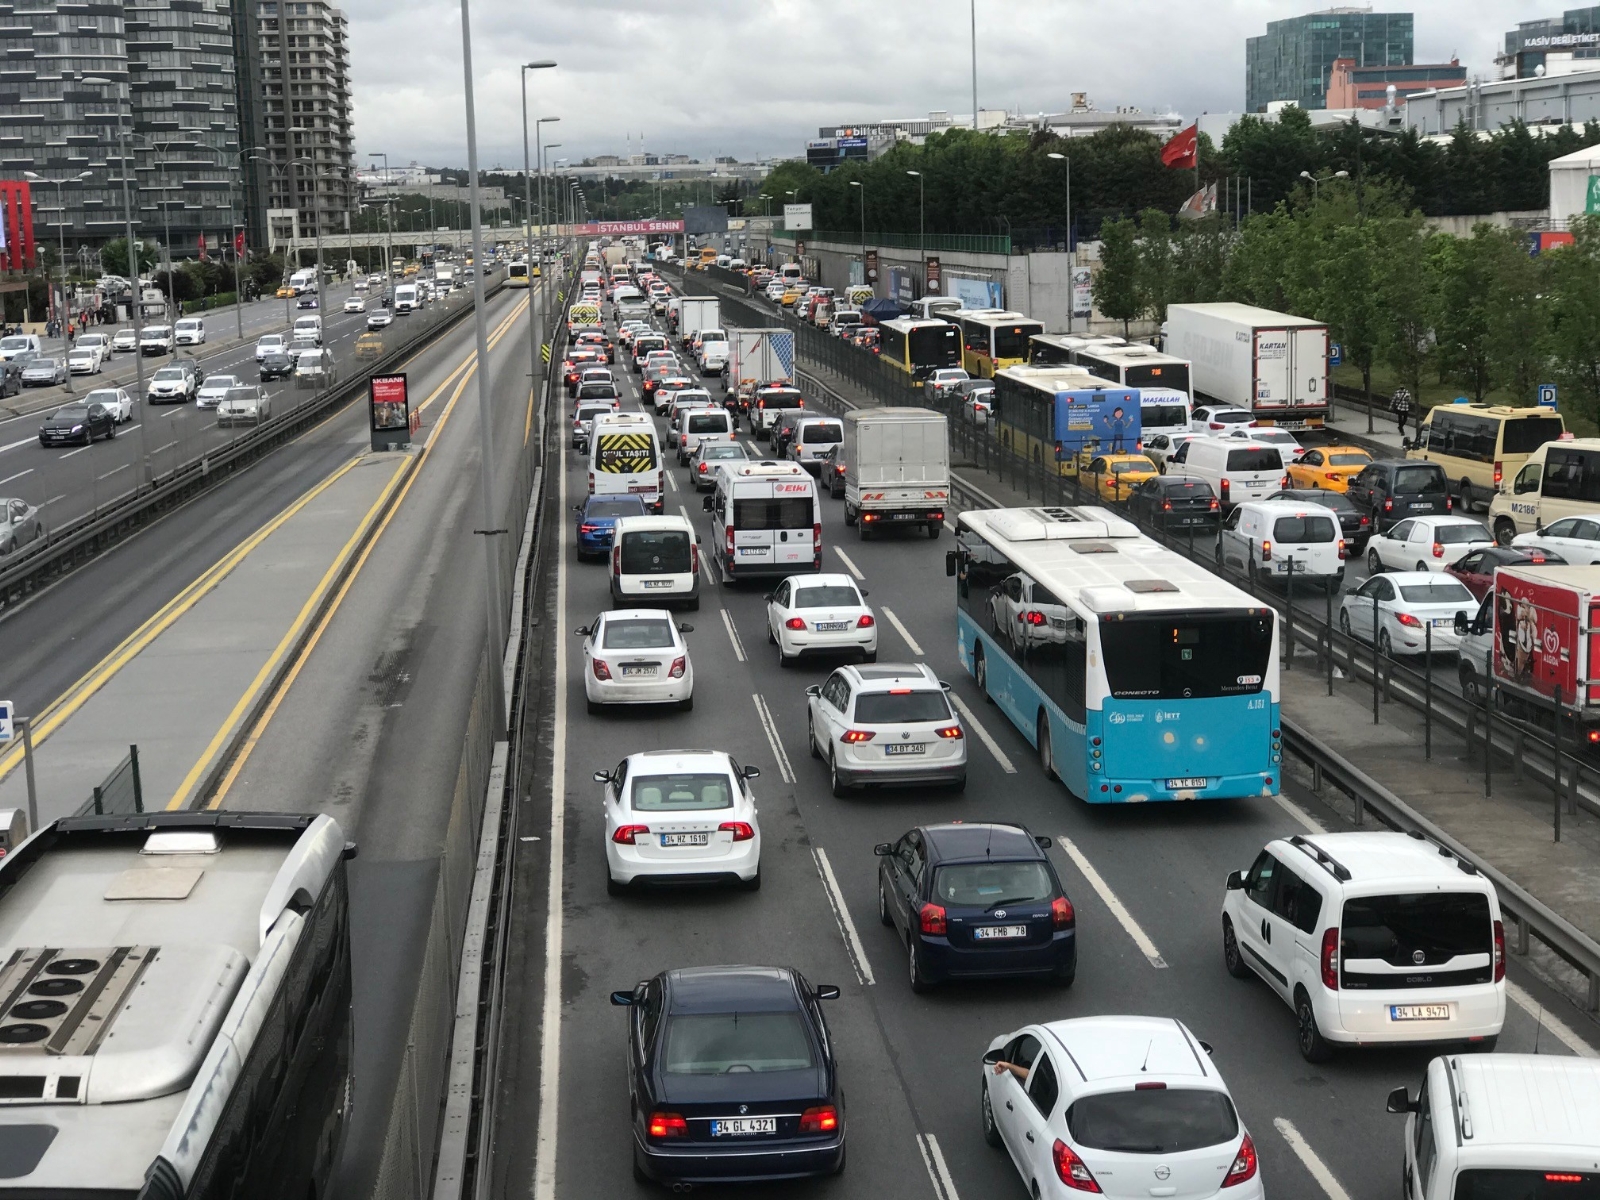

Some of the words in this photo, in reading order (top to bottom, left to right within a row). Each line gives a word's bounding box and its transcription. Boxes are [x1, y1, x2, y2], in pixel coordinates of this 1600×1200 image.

[597, 224, 646, 232] İSTANBUL
[649, 222, 680, 230] SENİN
[1544, 390, 1553, 401] D
[625, 450, 649, 458] TAŞITI
[1511, 503, 1535, 515] M2186
[1543, 654, 1559, 667] ALGIDA
[1247, 700, 1265, 709] A.151
[889, 745, 898, 753] 34
[900, 744, 909, 752] BT
[912, 744, 924, 752] 345
[1170, 780, 1178, 788] 34
[666, 835, 674, 843] 34
[677, 834, 685, 842] HZ
[980, 928, 989, 937] 34
[993, 927, 1007, 936] FMB
[1015, 926, 1025, 935] 78
[1397, 1008, 1407, 1017] 34
[1412, 1007, 1422, 1017] LA
[1426, 1006, 1446, 1016] 9471
[717, 1121, 729, 1133] 34
[733, 1120, 745, 1131] GL
[750, 1119, 774, 1131] 4321
